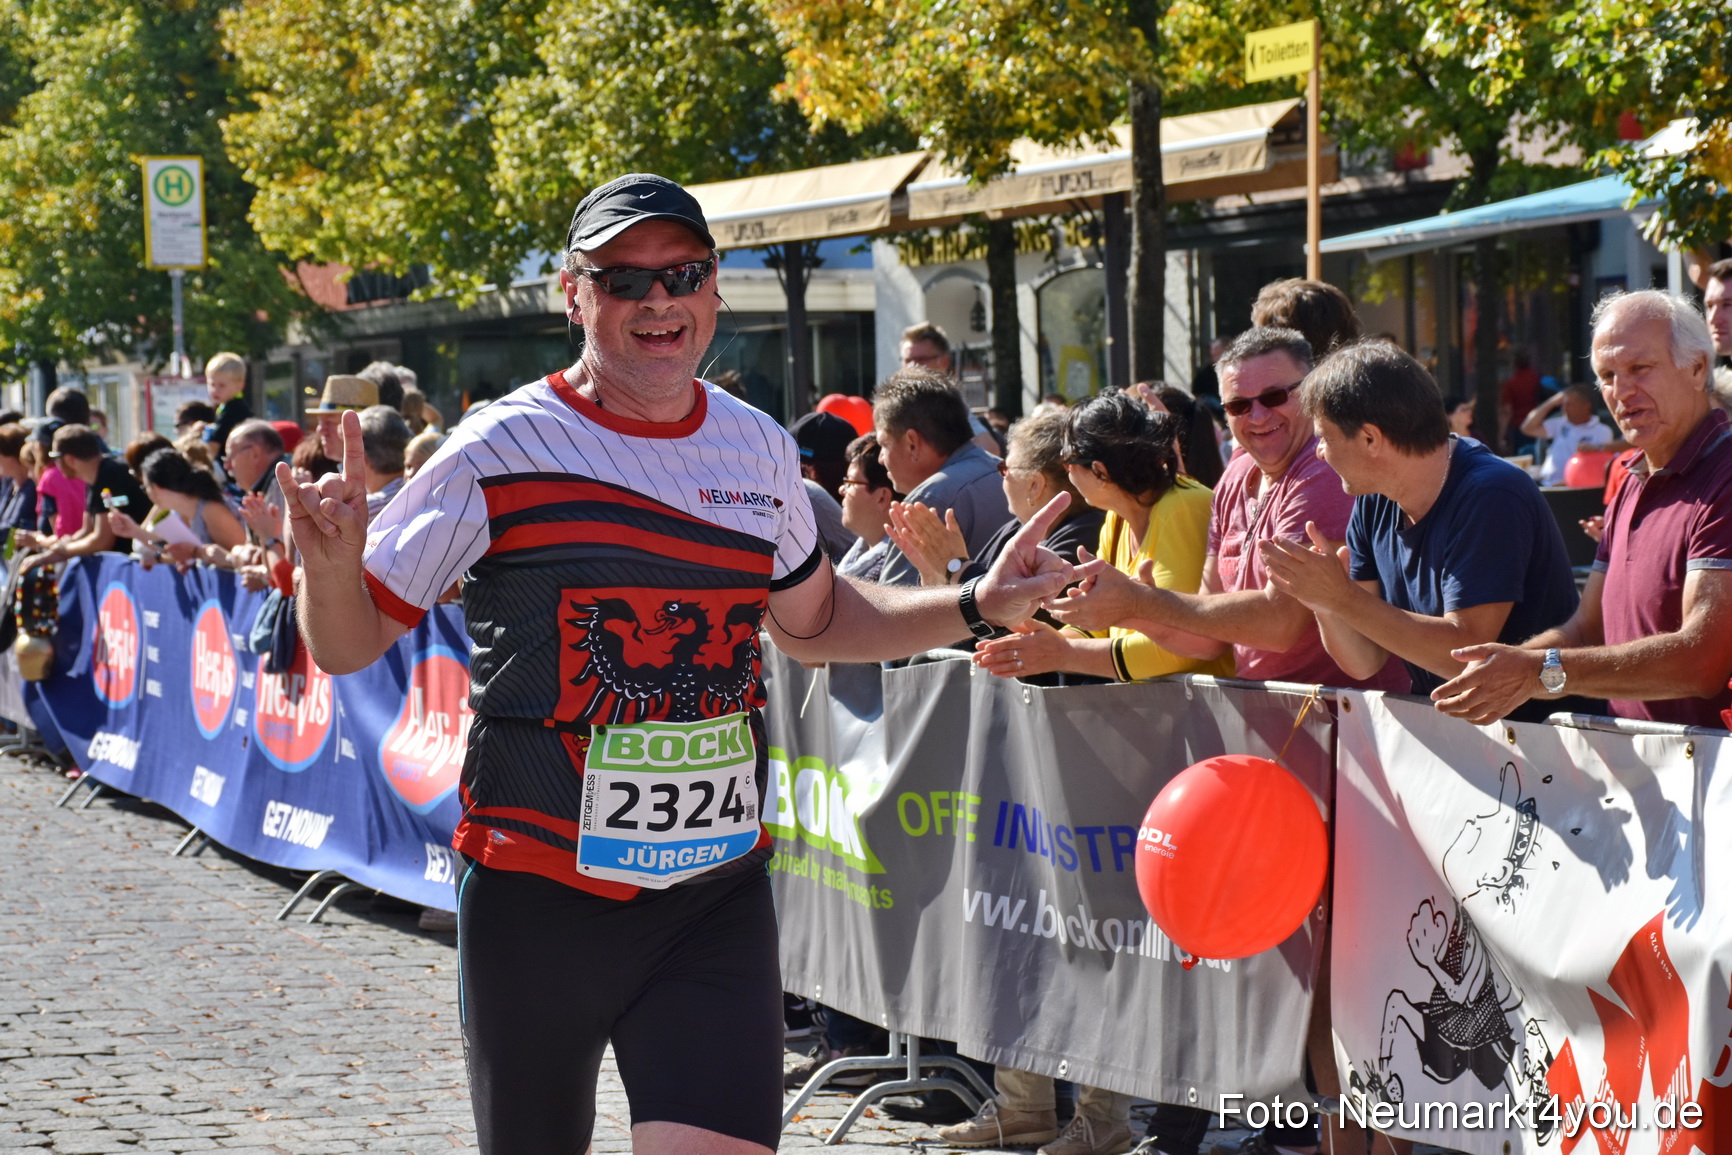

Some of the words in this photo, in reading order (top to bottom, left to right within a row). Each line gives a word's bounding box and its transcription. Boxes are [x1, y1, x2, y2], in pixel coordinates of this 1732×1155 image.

[1259, 41, 1309, 65] Toiletten
[699, 488, 774, 509] NEUMARKT
[605, 721, 748, 765] BOCK
[262, 800, 293, 840] GET
[606, 776, 745, 832] 2324
[424, 842, 450, 884] GET
[617, 842, 729, 870] JÜRGEN
[1144, 843, 1175, 860] energie
